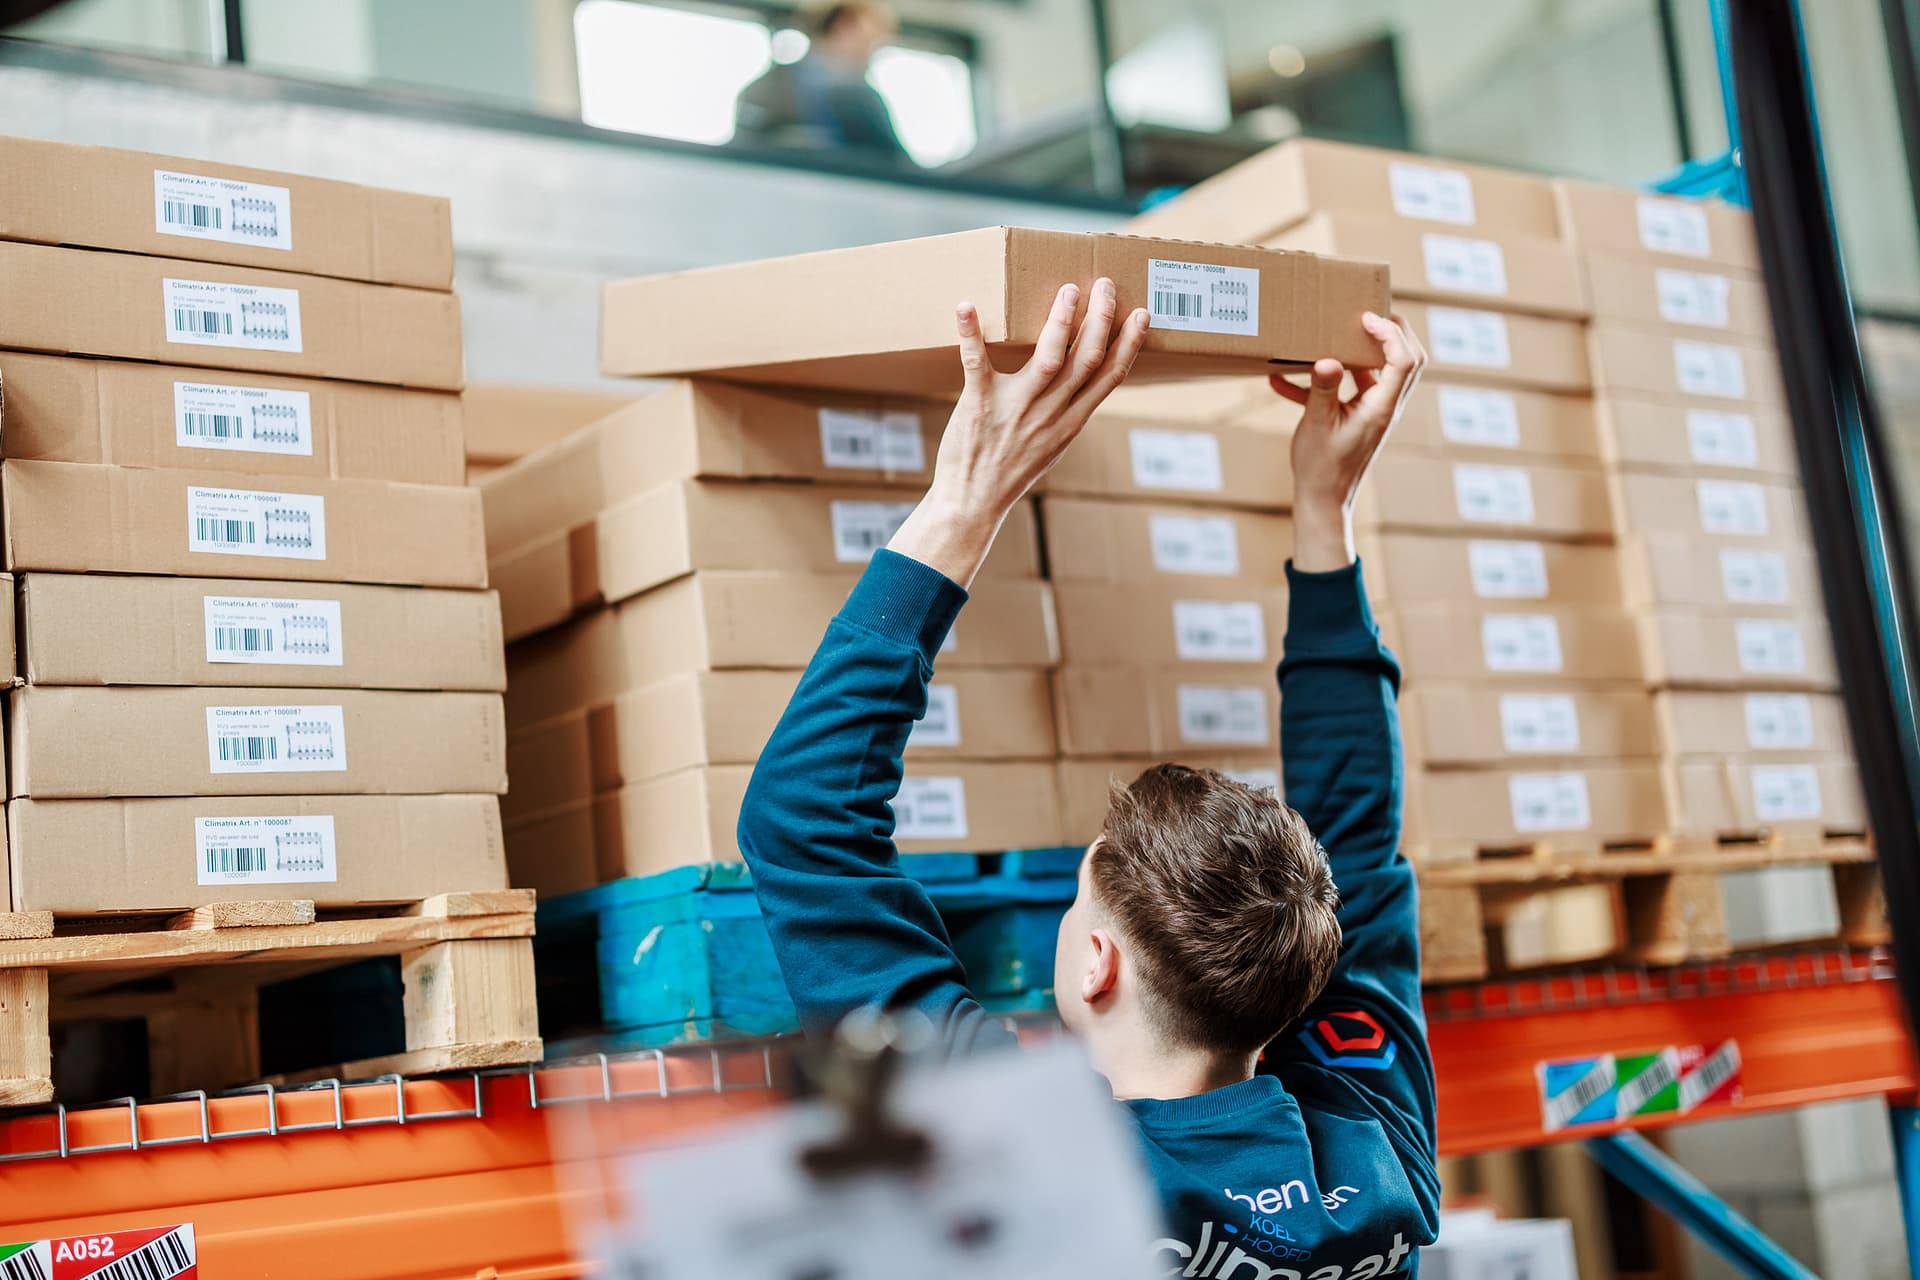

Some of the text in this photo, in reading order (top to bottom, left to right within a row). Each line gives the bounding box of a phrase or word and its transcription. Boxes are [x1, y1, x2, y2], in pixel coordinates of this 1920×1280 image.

[1155, 261, 1181, 269] Climatrix
[1249, 1213, 1297, 1242] KOEL
[56, 1237, 115, 1262] A052
[1242, 1233, 1312, 1261] HOOFD
